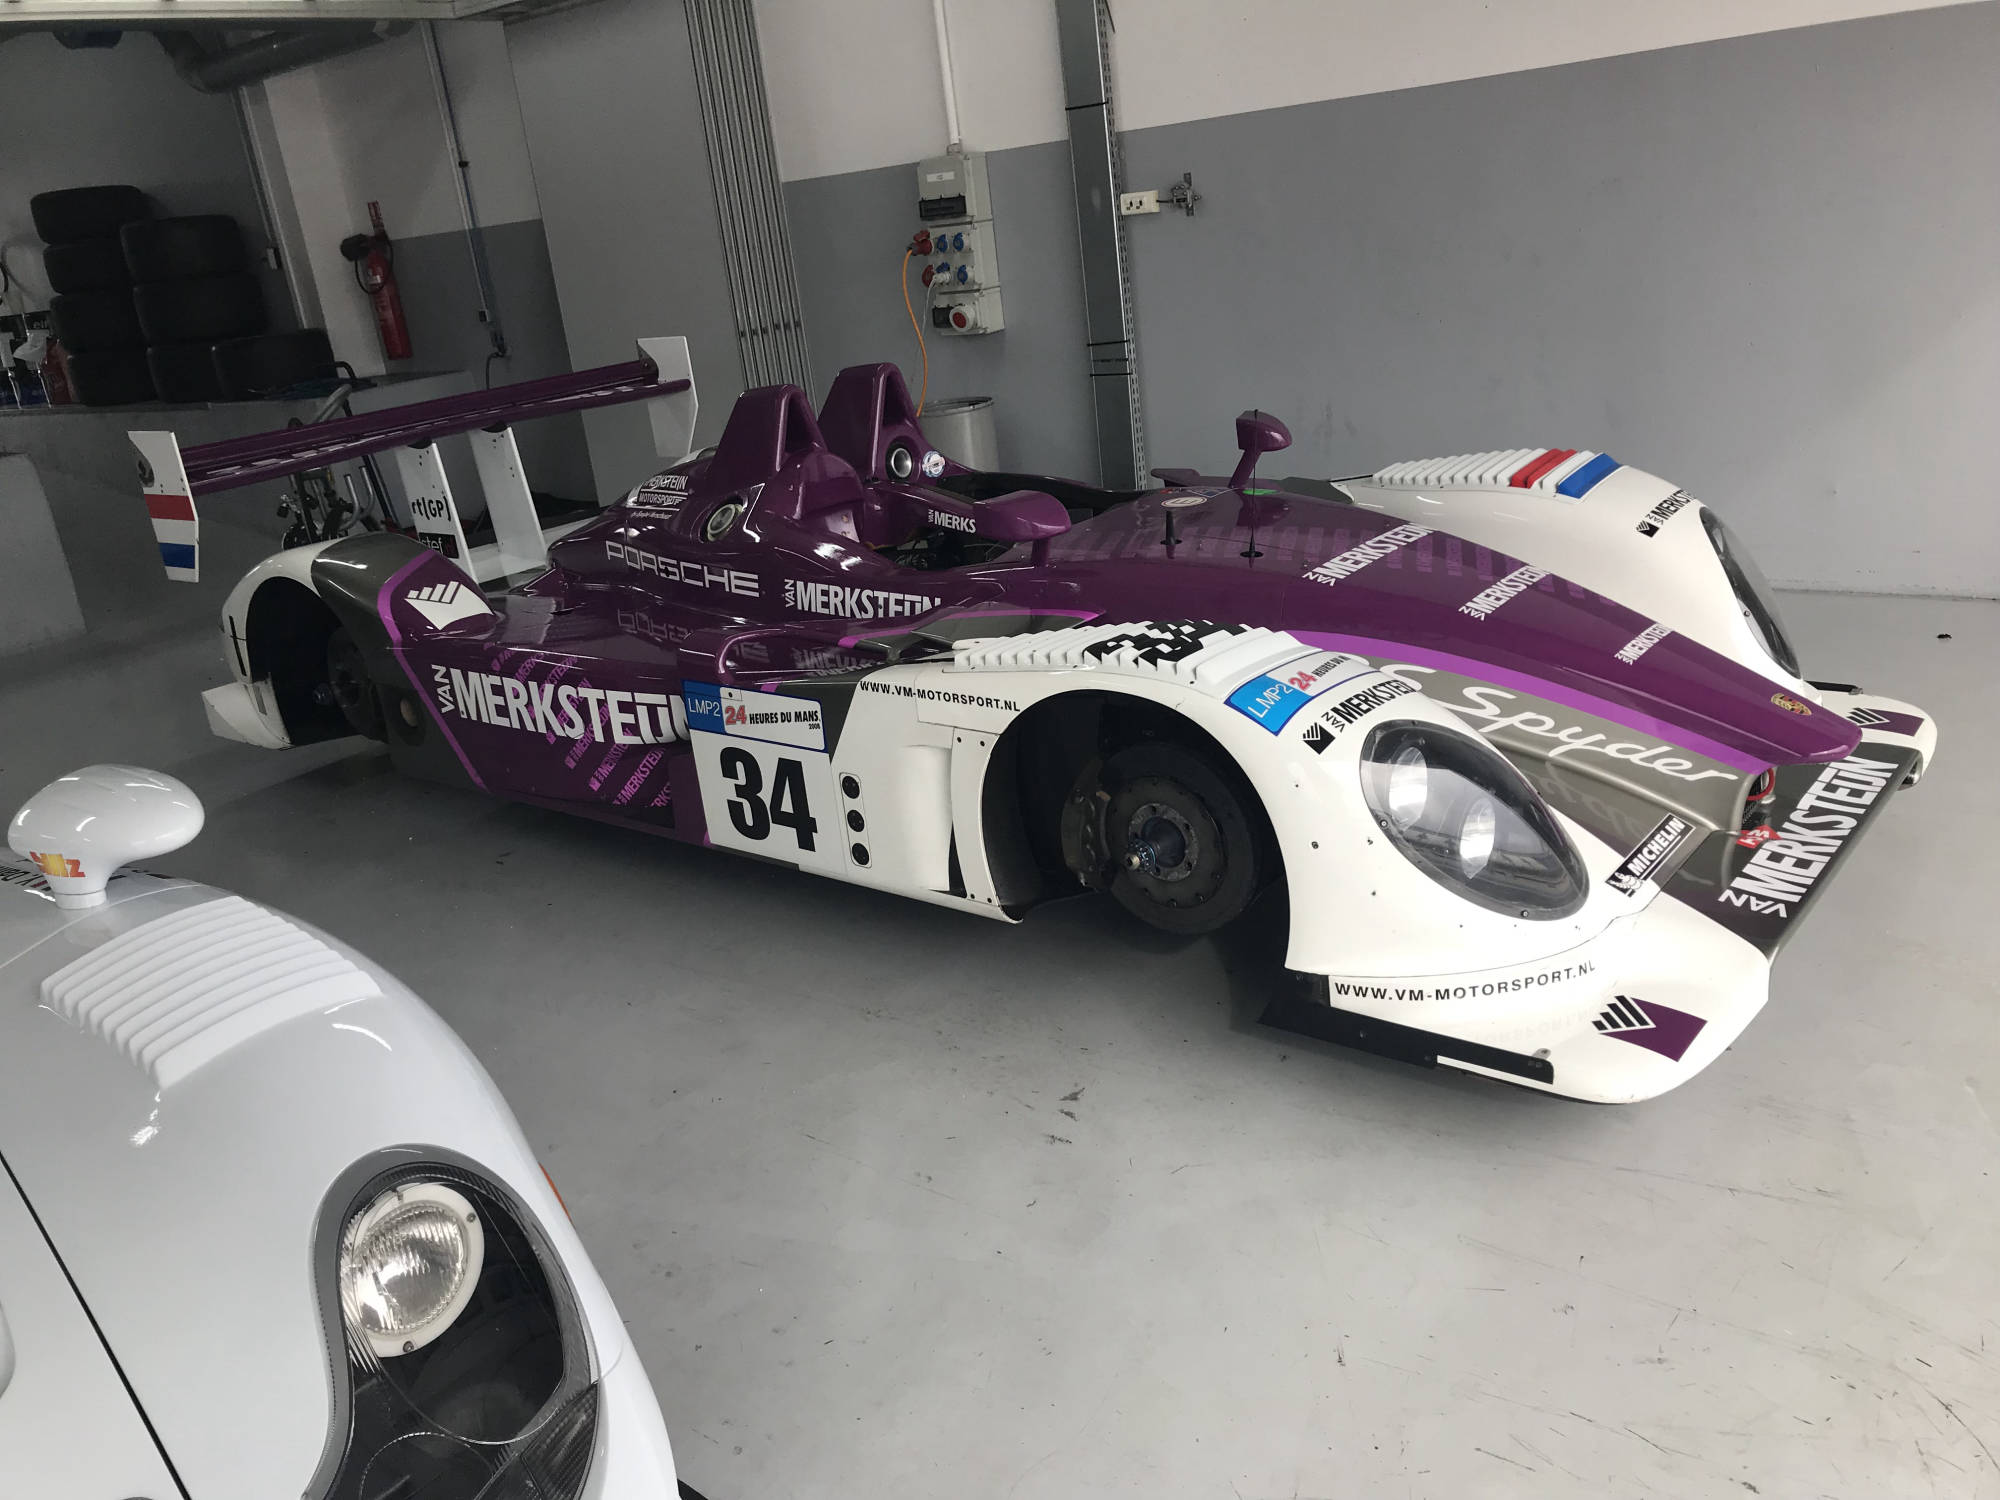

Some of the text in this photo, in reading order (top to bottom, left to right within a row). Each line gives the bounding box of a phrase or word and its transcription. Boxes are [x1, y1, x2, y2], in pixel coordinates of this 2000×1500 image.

[934, 510, 977, 534] MERKS
[605, 540, 761, 598] PORSCHE
[1302, 571, 1336, 587] VAN
[784, 578, 795, 608] VAN
[1458, 605, 1486, 621] VAN
[431, 663, 456, 714] VAN
[859, 680, 1021, 712] WWW.VM-MOTORSPORT.NL
[1248, 681, 1295, 719] LMP2
[1288, 670, 1318, 691] 24
[687, 698, 721, 717] LMP2
[724, 705, 748, 726] 24
[749, 711, 779, 725] HEURES
[780, 711, 793, 724] DU
[1321, 711, 1345, 733] VAN
[1436, 686, 1739, 781] Spyder
[719, 746, 818, 852] 34
[1626, 815, 1686, 877] MICHELIN
[1718, 888, 1788, 919] VAN
[1334, 959, 1597, 1002] WWW.VM-MOTORSPORT.NL
